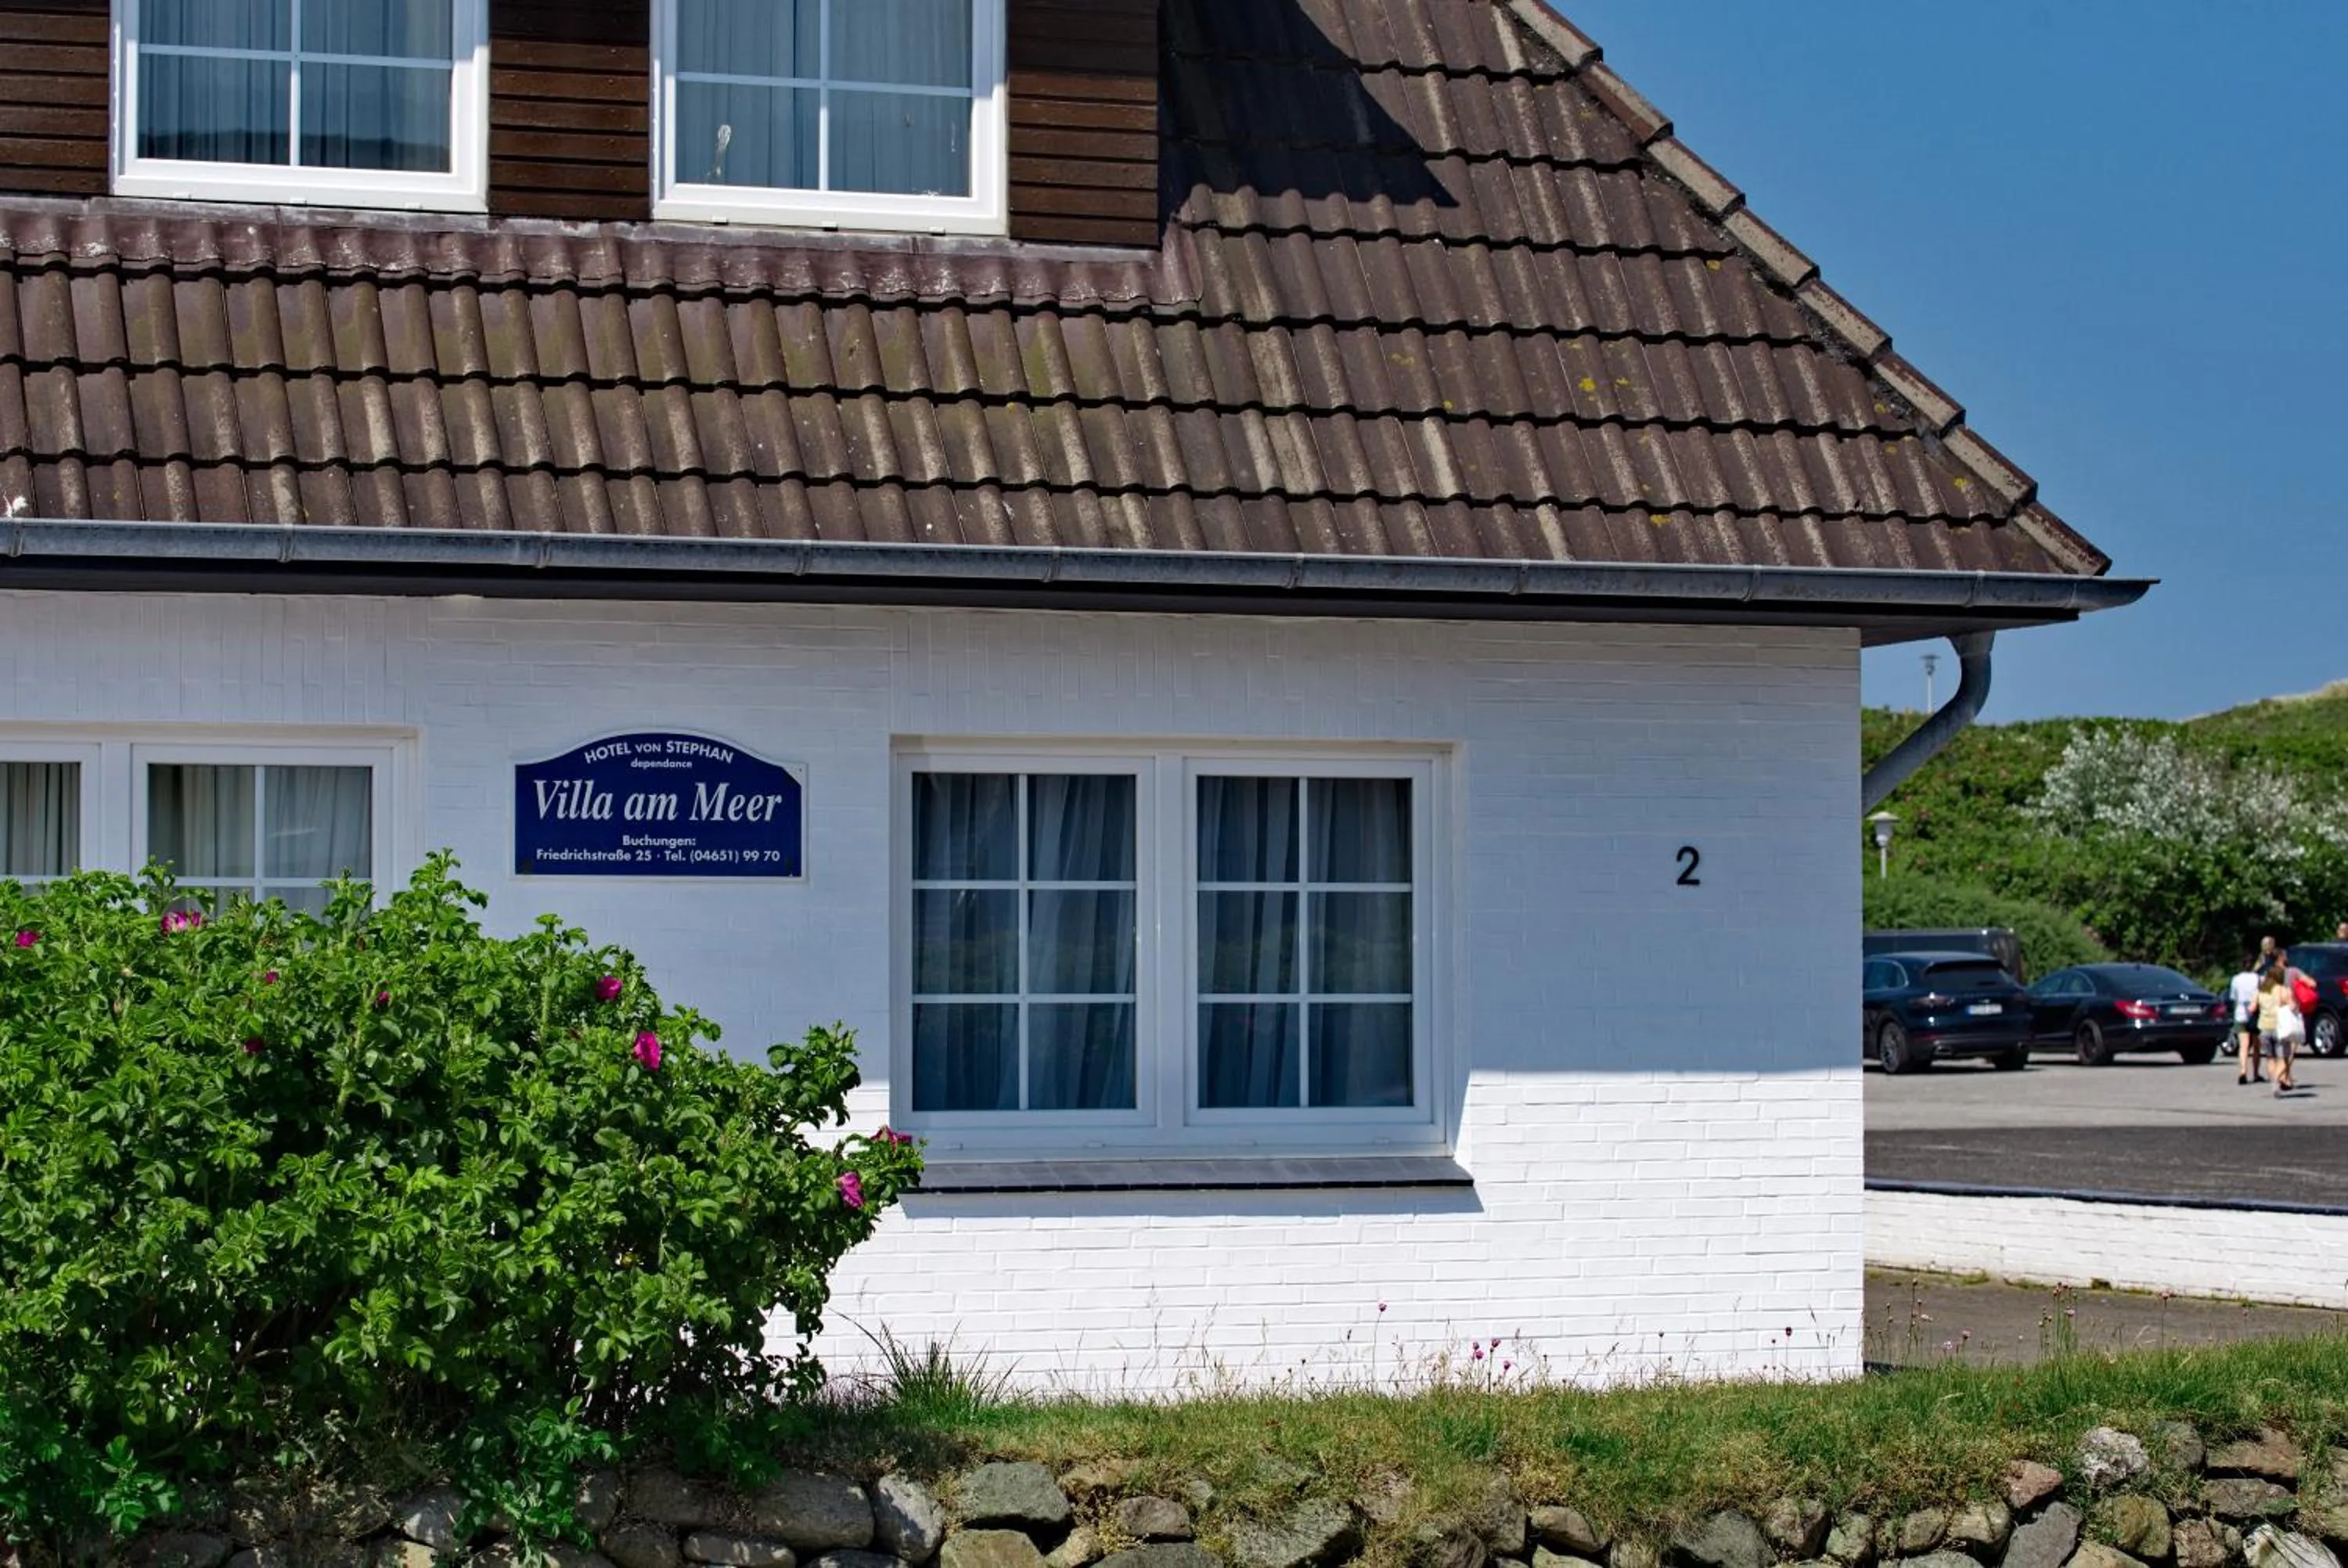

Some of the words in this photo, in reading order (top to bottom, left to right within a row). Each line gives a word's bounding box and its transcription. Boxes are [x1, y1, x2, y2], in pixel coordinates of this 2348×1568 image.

[584, 742, 632, 764] HOTEL
[636, 743, 661, 753] VON
[666, 740, 733, 763] STEPHAN
[630, 758, 693, 770] dependance
[533, 779, 613, 819] Villa
[624, 792, 679, 821] am
[689, 782, 783, 822] Meer
[622, 834, 696, 849] Buchungen:
[536, 847, 632, 861] Friedrichstraße
[636, 850, 652, 861] 25
[664, 850, 686, 861] Tel.
[690, 850, 740, 864] (04651)
[743, 851, 759, 861] 99
[763, 851, 780, 861] 70
[1676, 846, 1700, 885] 2
